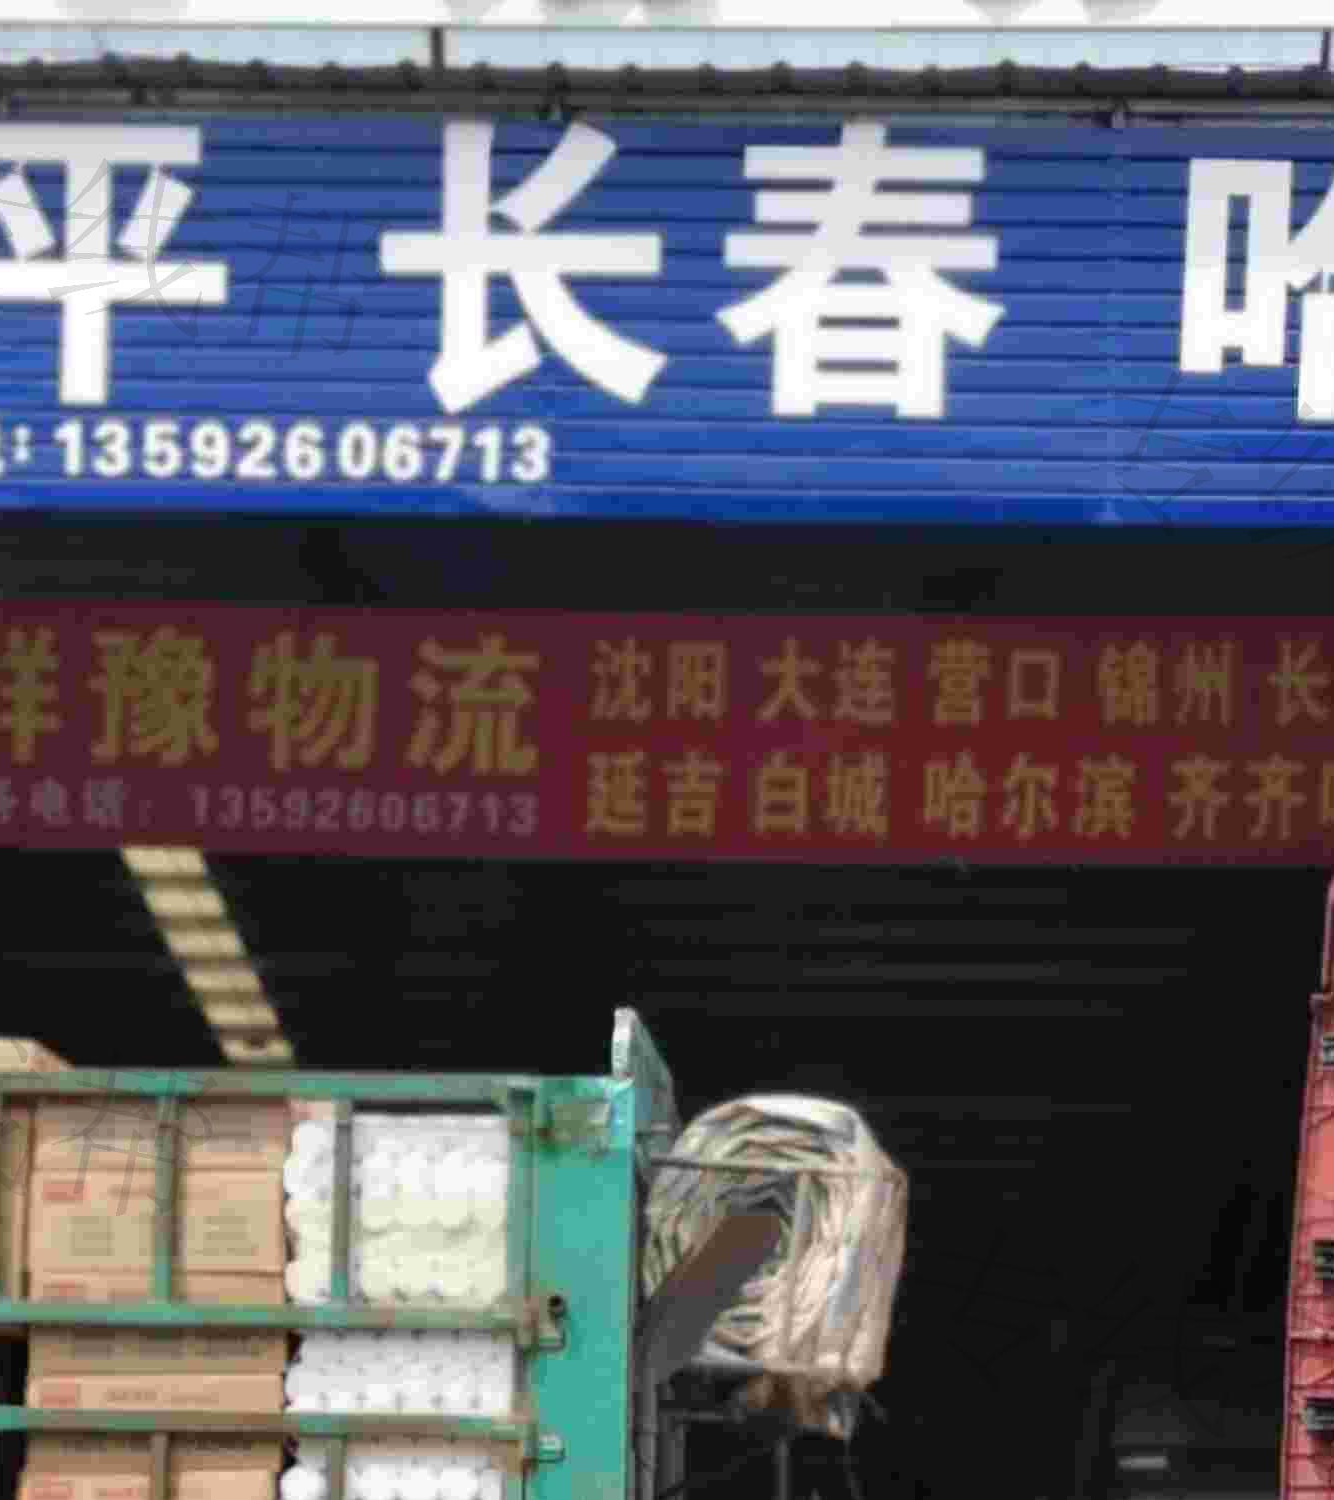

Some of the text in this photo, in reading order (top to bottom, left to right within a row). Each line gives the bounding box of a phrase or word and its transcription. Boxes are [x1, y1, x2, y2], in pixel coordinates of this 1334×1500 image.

[379, 118, 1006, 420] 长春
[588, 634, 729, 724] 沈阳
[753, 634, 896, 727] 大连
[928, 636, 1061, 727] 营口
[1098, 639, 1234, 728] 锦州
[581, 746, 723, 840] 延吉
[921, 746, 1136, 842] 哈尔滨
